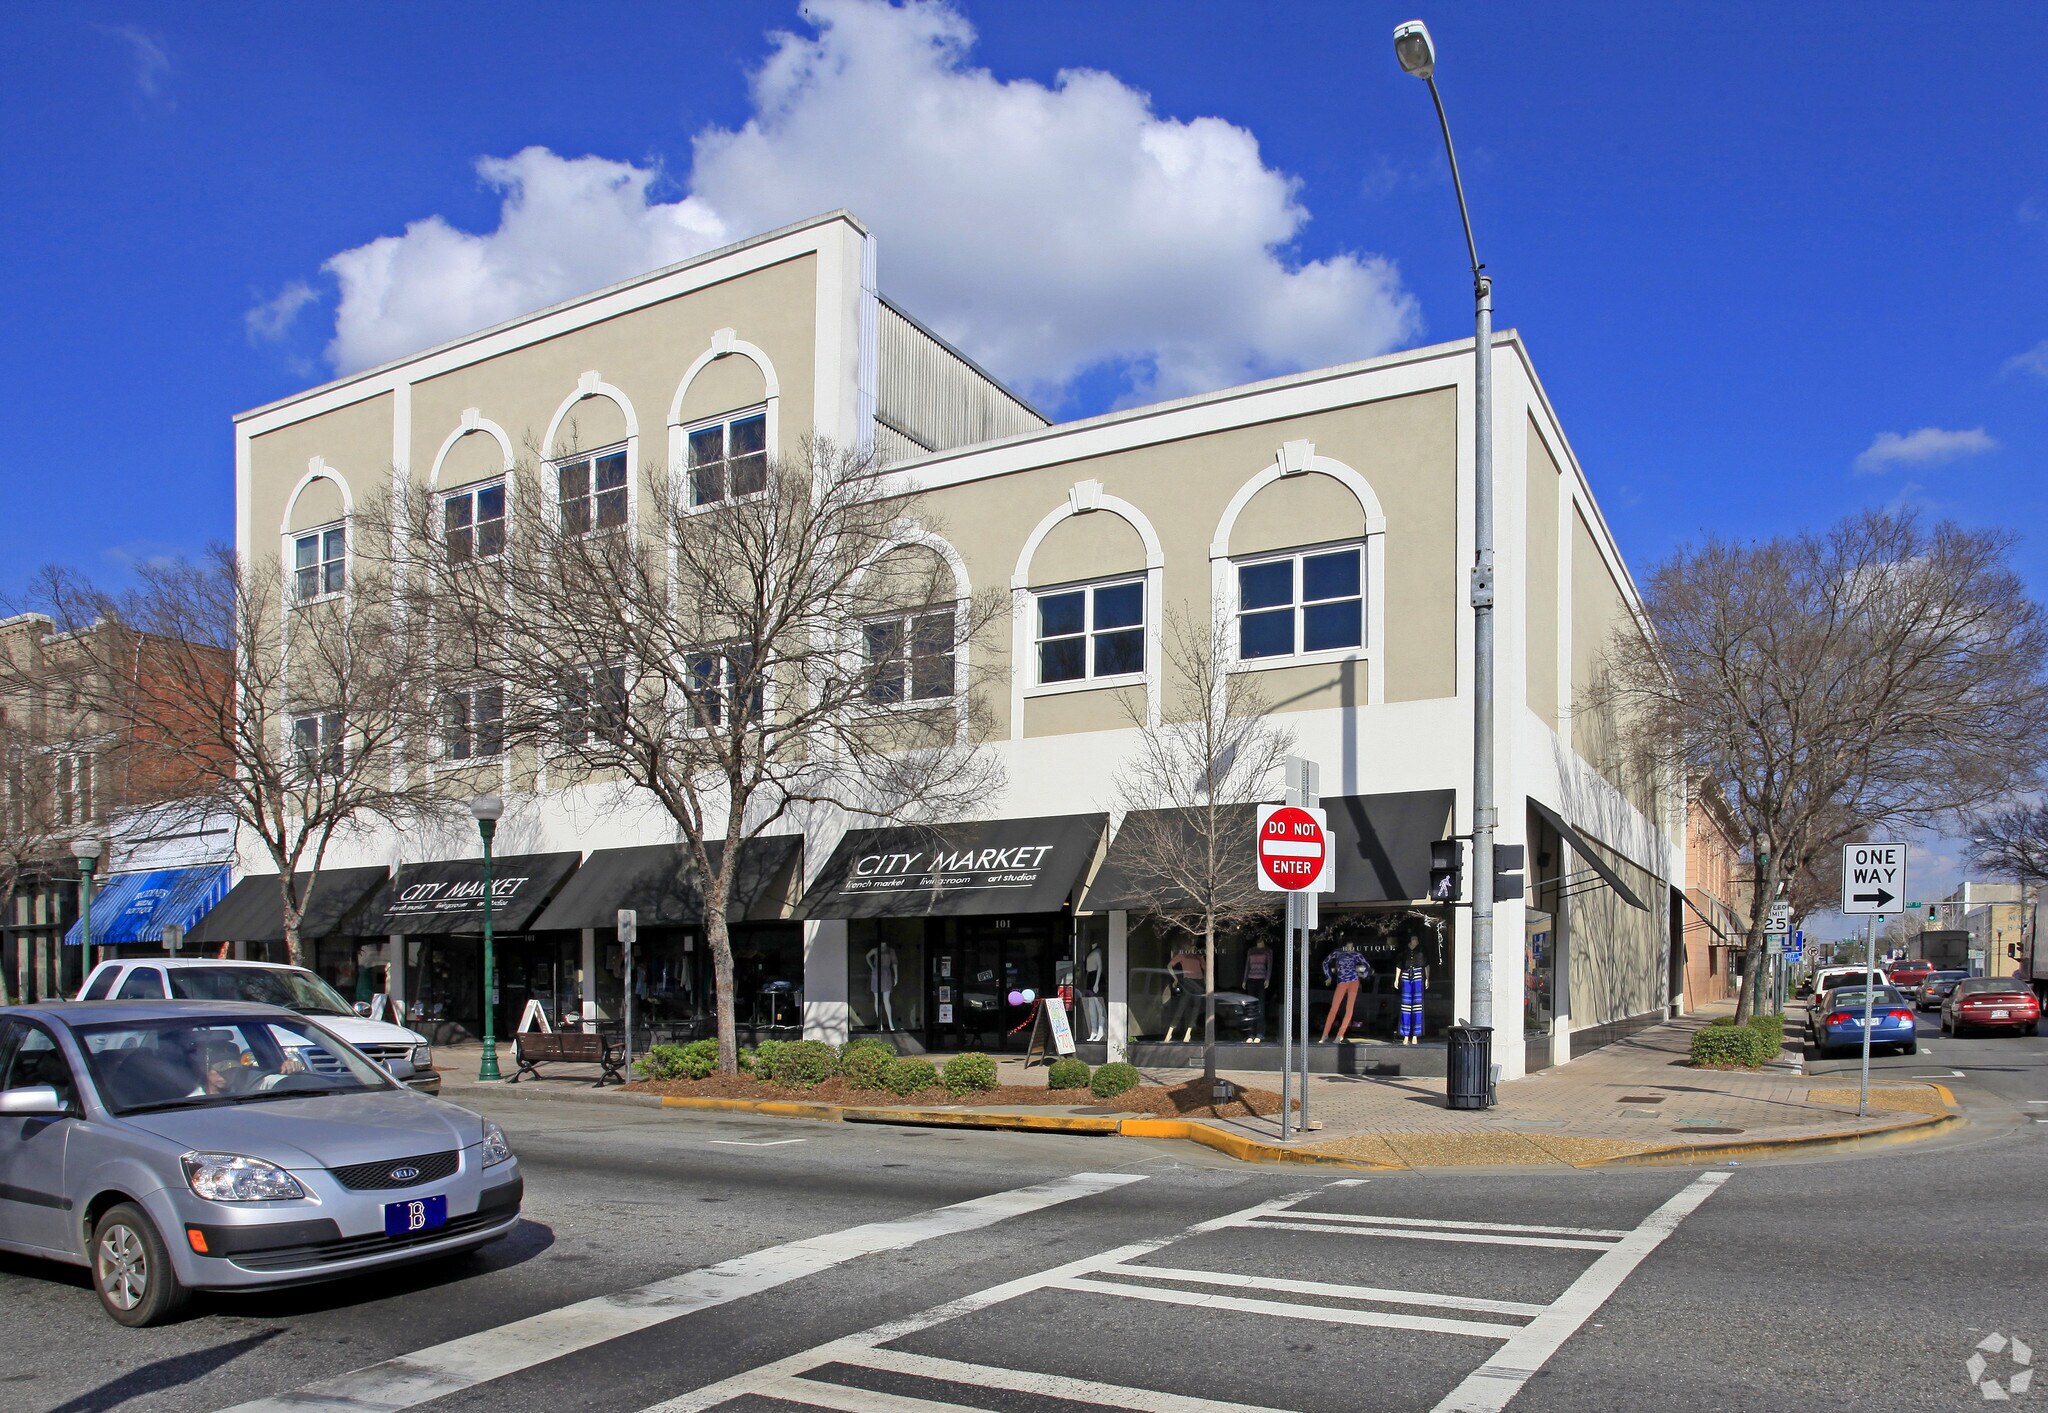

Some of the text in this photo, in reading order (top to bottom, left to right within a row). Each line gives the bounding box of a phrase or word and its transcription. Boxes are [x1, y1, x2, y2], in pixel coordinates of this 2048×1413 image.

[1269, 821, 1316, 836] DO NOT
[856, 846, 1054, 875] CITY MARKET
[1855, 849, 1896, 865] ONE
[1273, 860, 1312, 874] ENTER
[874, 879, 905, 887] market
[987, 875, 1001, 883] art
[1003, 873, 1037, 882] studios
[1854, 868, 1897, 884] WAY
[400, 882, 448, 901] CITY
[995, 920, 1011, 928] 101
[1764, 918, 1787, 930] 25
[524, 934, 536, 942] 101
[395, 1168, 416, 1178] KIA
[408, 1201, 426, 1230] B
